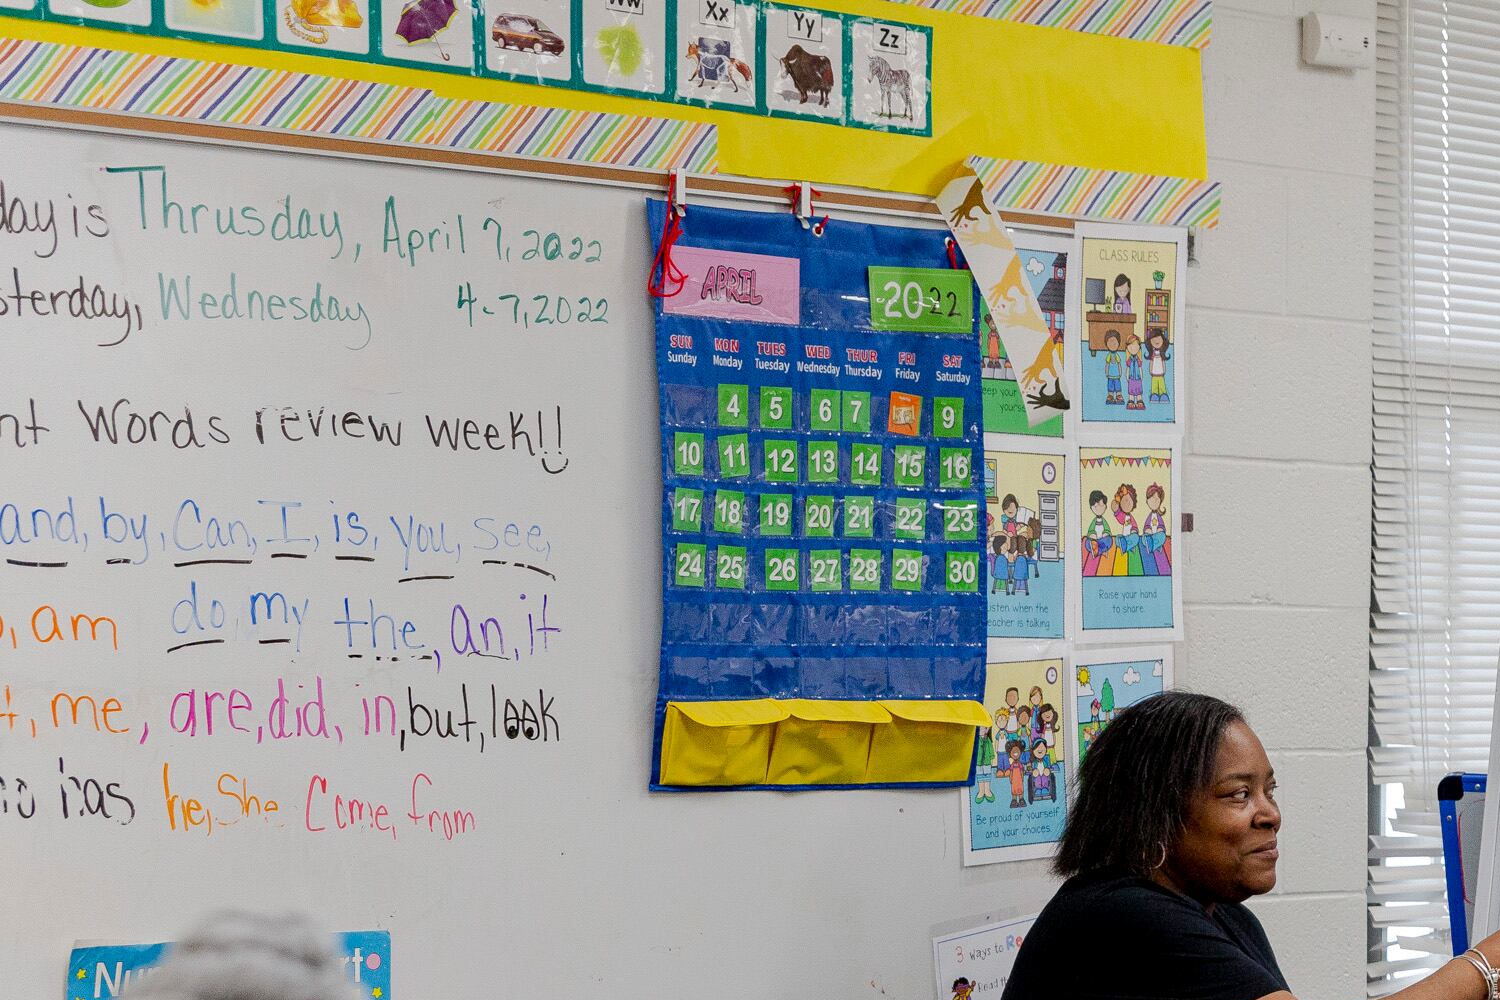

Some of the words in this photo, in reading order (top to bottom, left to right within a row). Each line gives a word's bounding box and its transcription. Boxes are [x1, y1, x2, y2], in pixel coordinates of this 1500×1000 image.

[706, 2, 729, 21] Xx
[794, 12, 816, 37] Yy
[879, 28, 900, 49] Zz
[68, 193, 110, 238] is
[382, 195, 466, 268] April
[1100, 249, 1128, 261] CLASS
[1131, 250, 1159, 262] RULES
[701, 265, 763, 305] APRIL
[157, 272, 372, 351] Wednesday
[670, 335, 693, 348] SUN
[714, 338, 740, 352] MON
[757, 342, 786, 356] TUES
[805, 345, 831, 359] WED
[667, 351, 697, 367] Sunday
[713, 354, 743, 370] Monday
[754, 358, 790, 374] Tuesday
[846, 348, 878, 362] THUR
[898, 352, 916, 366] FRI
[942, 354, 962, 369] SAT
[796, 362, 840, 377] Wednesday
[844, 364, 882, 379] Thursday
[895, 367, 920, 383] Friday
[935, 370, 971, 385] Saturday
[726, 394, 739, 417] 4
[769, 397, 783, 420] 5
[818, 399, 832, 422] 6
[850, 401, 862, 423] 7
[942, 405, 955, 429] 9
[77, 398, 230, 450] Words
[256, 405, 401, 449] review
[426, 405, 563, 458] week!!
[678, 441, 700, 466] 10
[723, 442, 747, 467] 11
[768, 449, 795, 472] 12
[810, 450, 835, 473] 13
[854, 452, 878, 475] 14
[897, 453, 921, 477] 15
[942, 455, 968, 479] 16
[676, 497, 700, 522] 17
[718, 499, 740, 524] 18
[763, 502, 789, 526] 19
[808, 504, 831, 528] 20
[850, 505, 870, 528] 21
[898, 508, 923, 531] 22
[947, 509, 974, 532] 23
[678, 553, 702, 577] 24
[719, 555, 743, 580] 25
[768, 557, 795, 581] 26
[813, 559, 838, 583] 27
[853, 558, 877, 582] 28
[895, 558, 919, 582] 29
[949, 560, 975, 583] 30
[1099, 589, 1119, 600] Raise
[1121, 591, 1138, 601] your
[31, 606, 118, 650] am
[250, 592, 309, 652] my
[518, 593, 562, 656] it
[491, 684, 560, 742] look
[408, 773, 476, 841] from
[976, 815, 987, 826] Be
[990, 811, 1013, 828] proud
[1014, 810, 1024, 822] of
[1026, 807, 1060, 827] yourself
[985, 828, 999, 839] and
[1001, 826, 1019, 840] your
[955, 945, 964, 963] 3
[969, 946, 991, 961] ways
